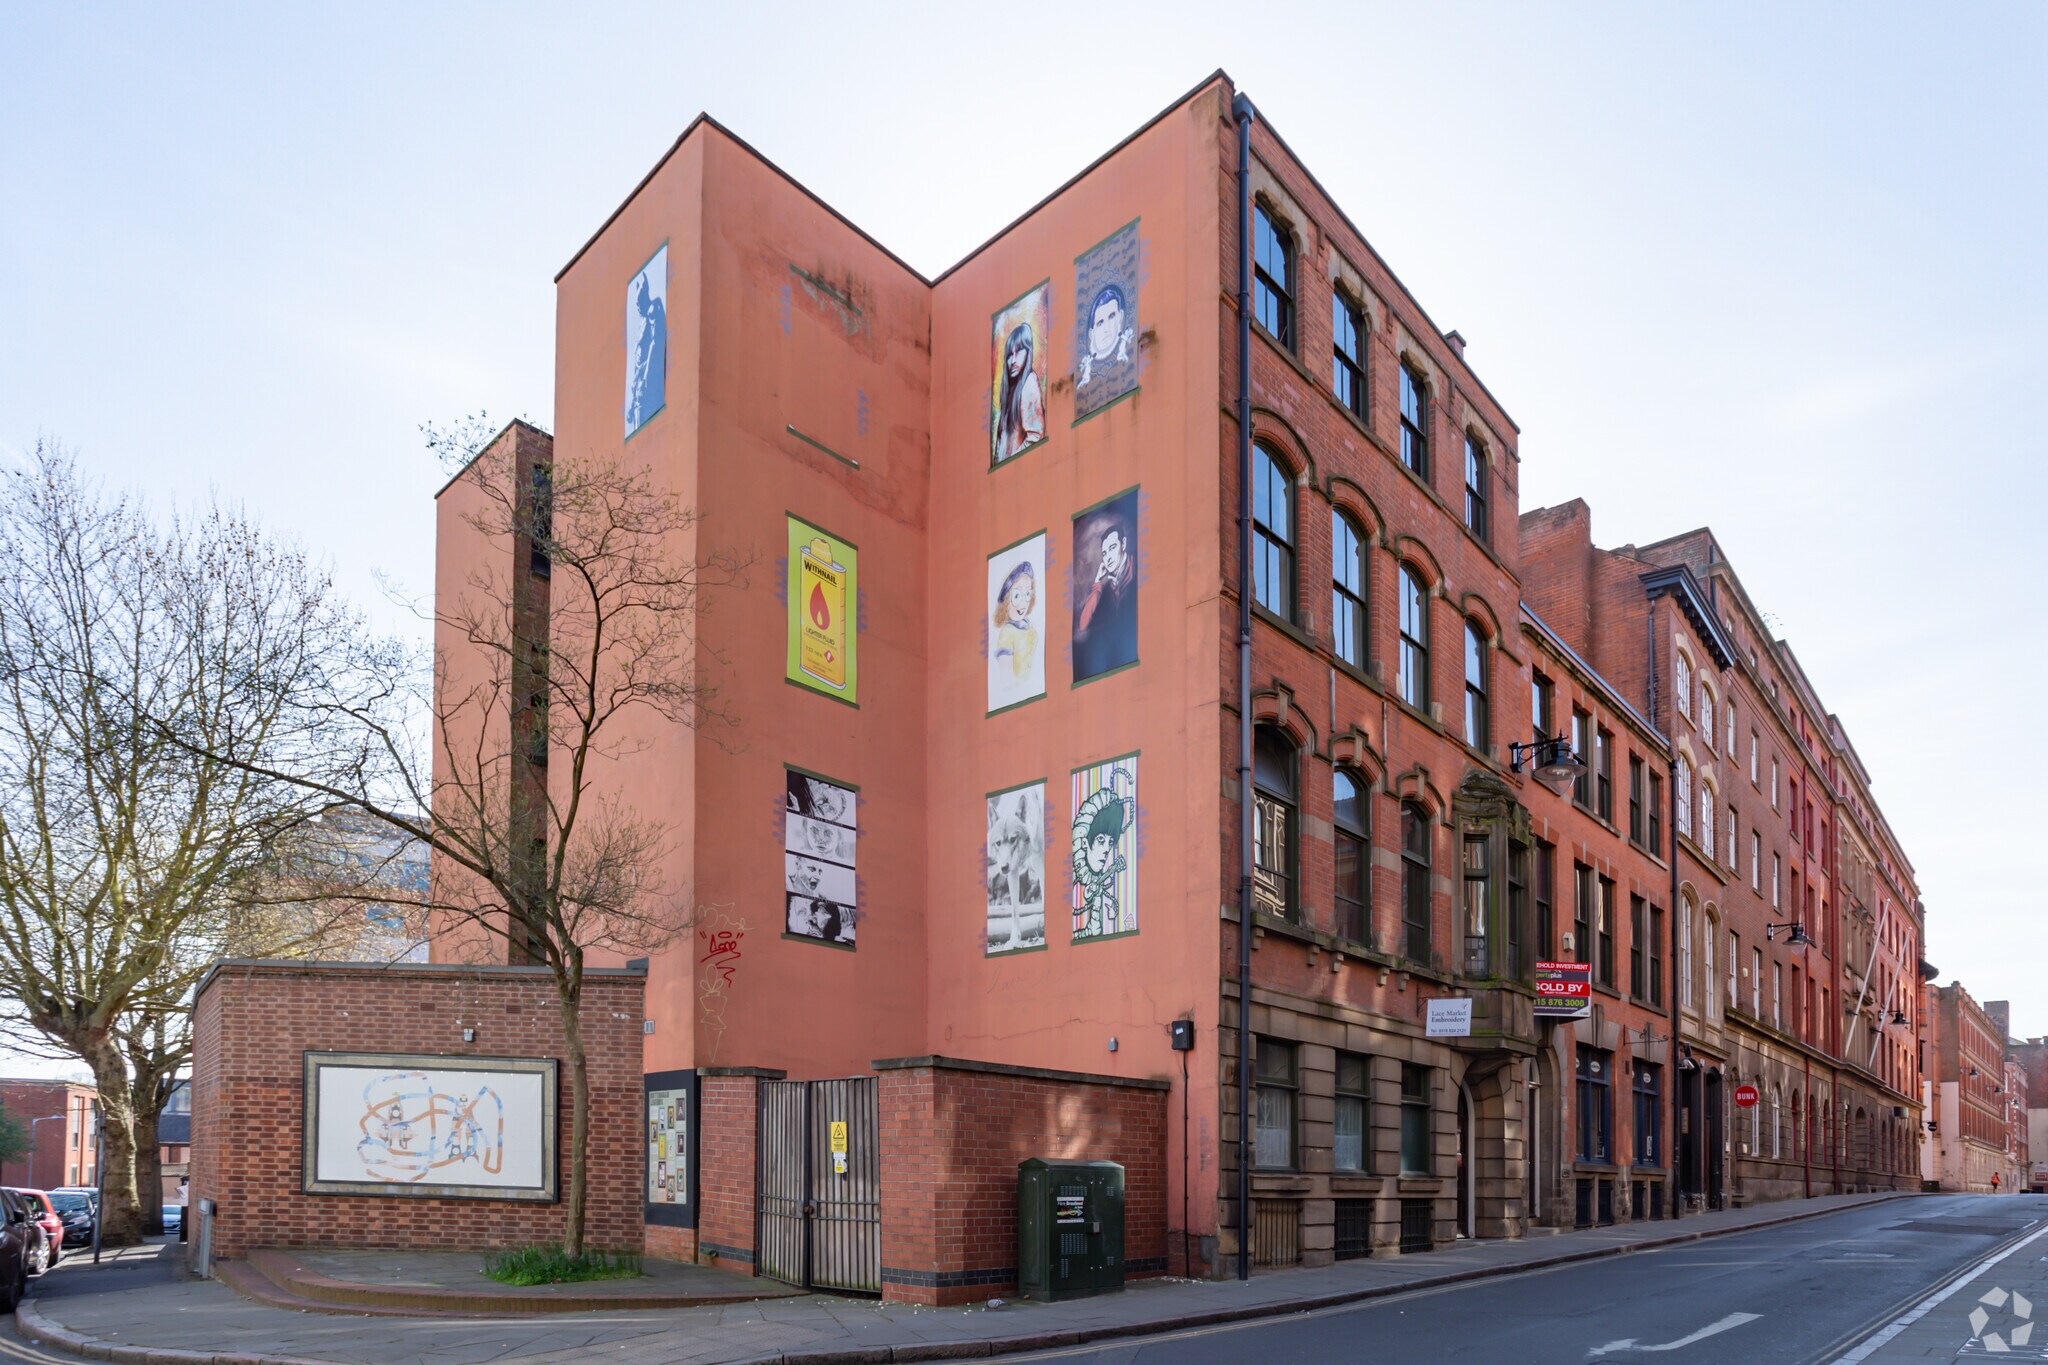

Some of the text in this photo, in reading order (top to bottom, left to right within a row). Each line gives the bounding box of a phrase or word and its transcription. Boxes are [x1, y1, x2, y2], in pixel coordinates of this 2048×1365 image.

[804, 560, 837, 585] WITHNAIL
[805, 626, 822, 638] LIGHTER
[822, 635, 836, 646] FLUID
[1568, 984, 1583, 993] BY
[1565, 999, 1585, 1007] 3000
[1737, 1092, 1755, 1100] BUNK
